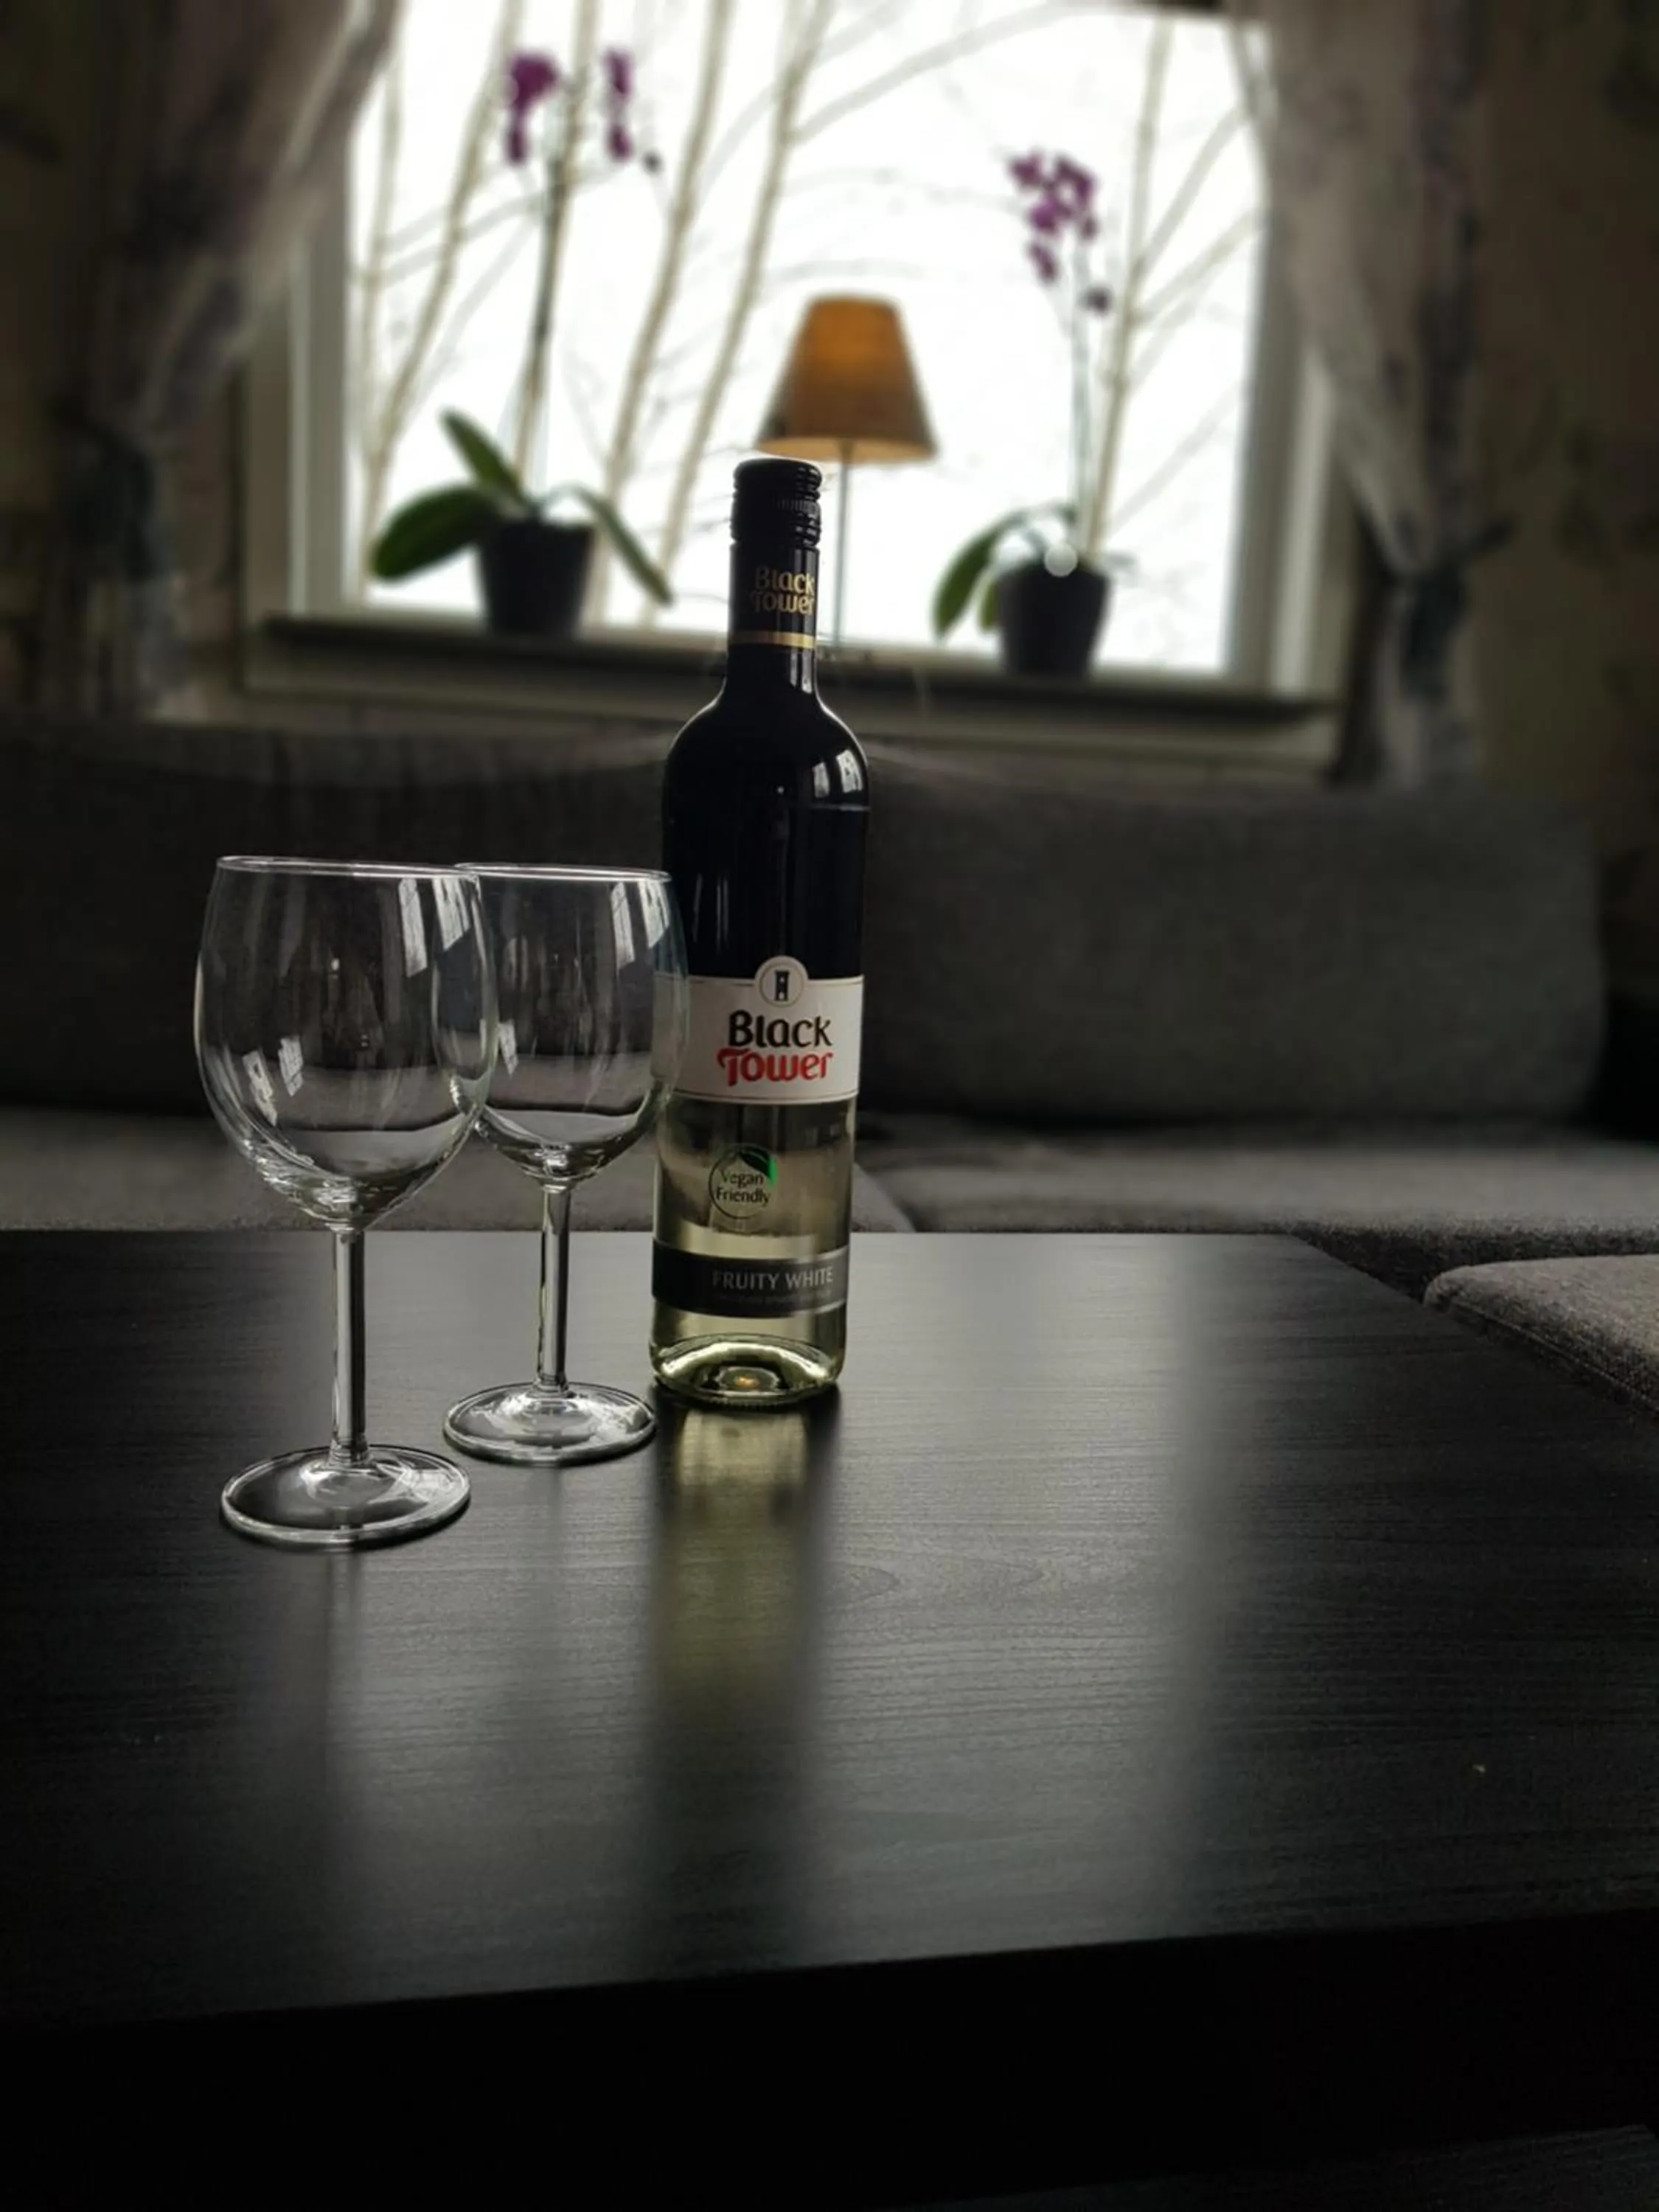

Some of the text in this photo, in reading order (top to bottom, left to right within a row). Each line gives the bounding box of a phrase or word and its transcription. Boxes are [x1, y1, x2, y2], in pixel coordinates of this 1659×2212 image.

[755, 566, 815, 594] Black
[728, 1010, 832, 1047] Black
[717, 1048, 833, 1086] Tower
[720, 1172, 764, 1187] Vegan
[715, 1186, 771, 1206] Friendly
[712, 1267, 833, 1290] FRUITY WHITE
